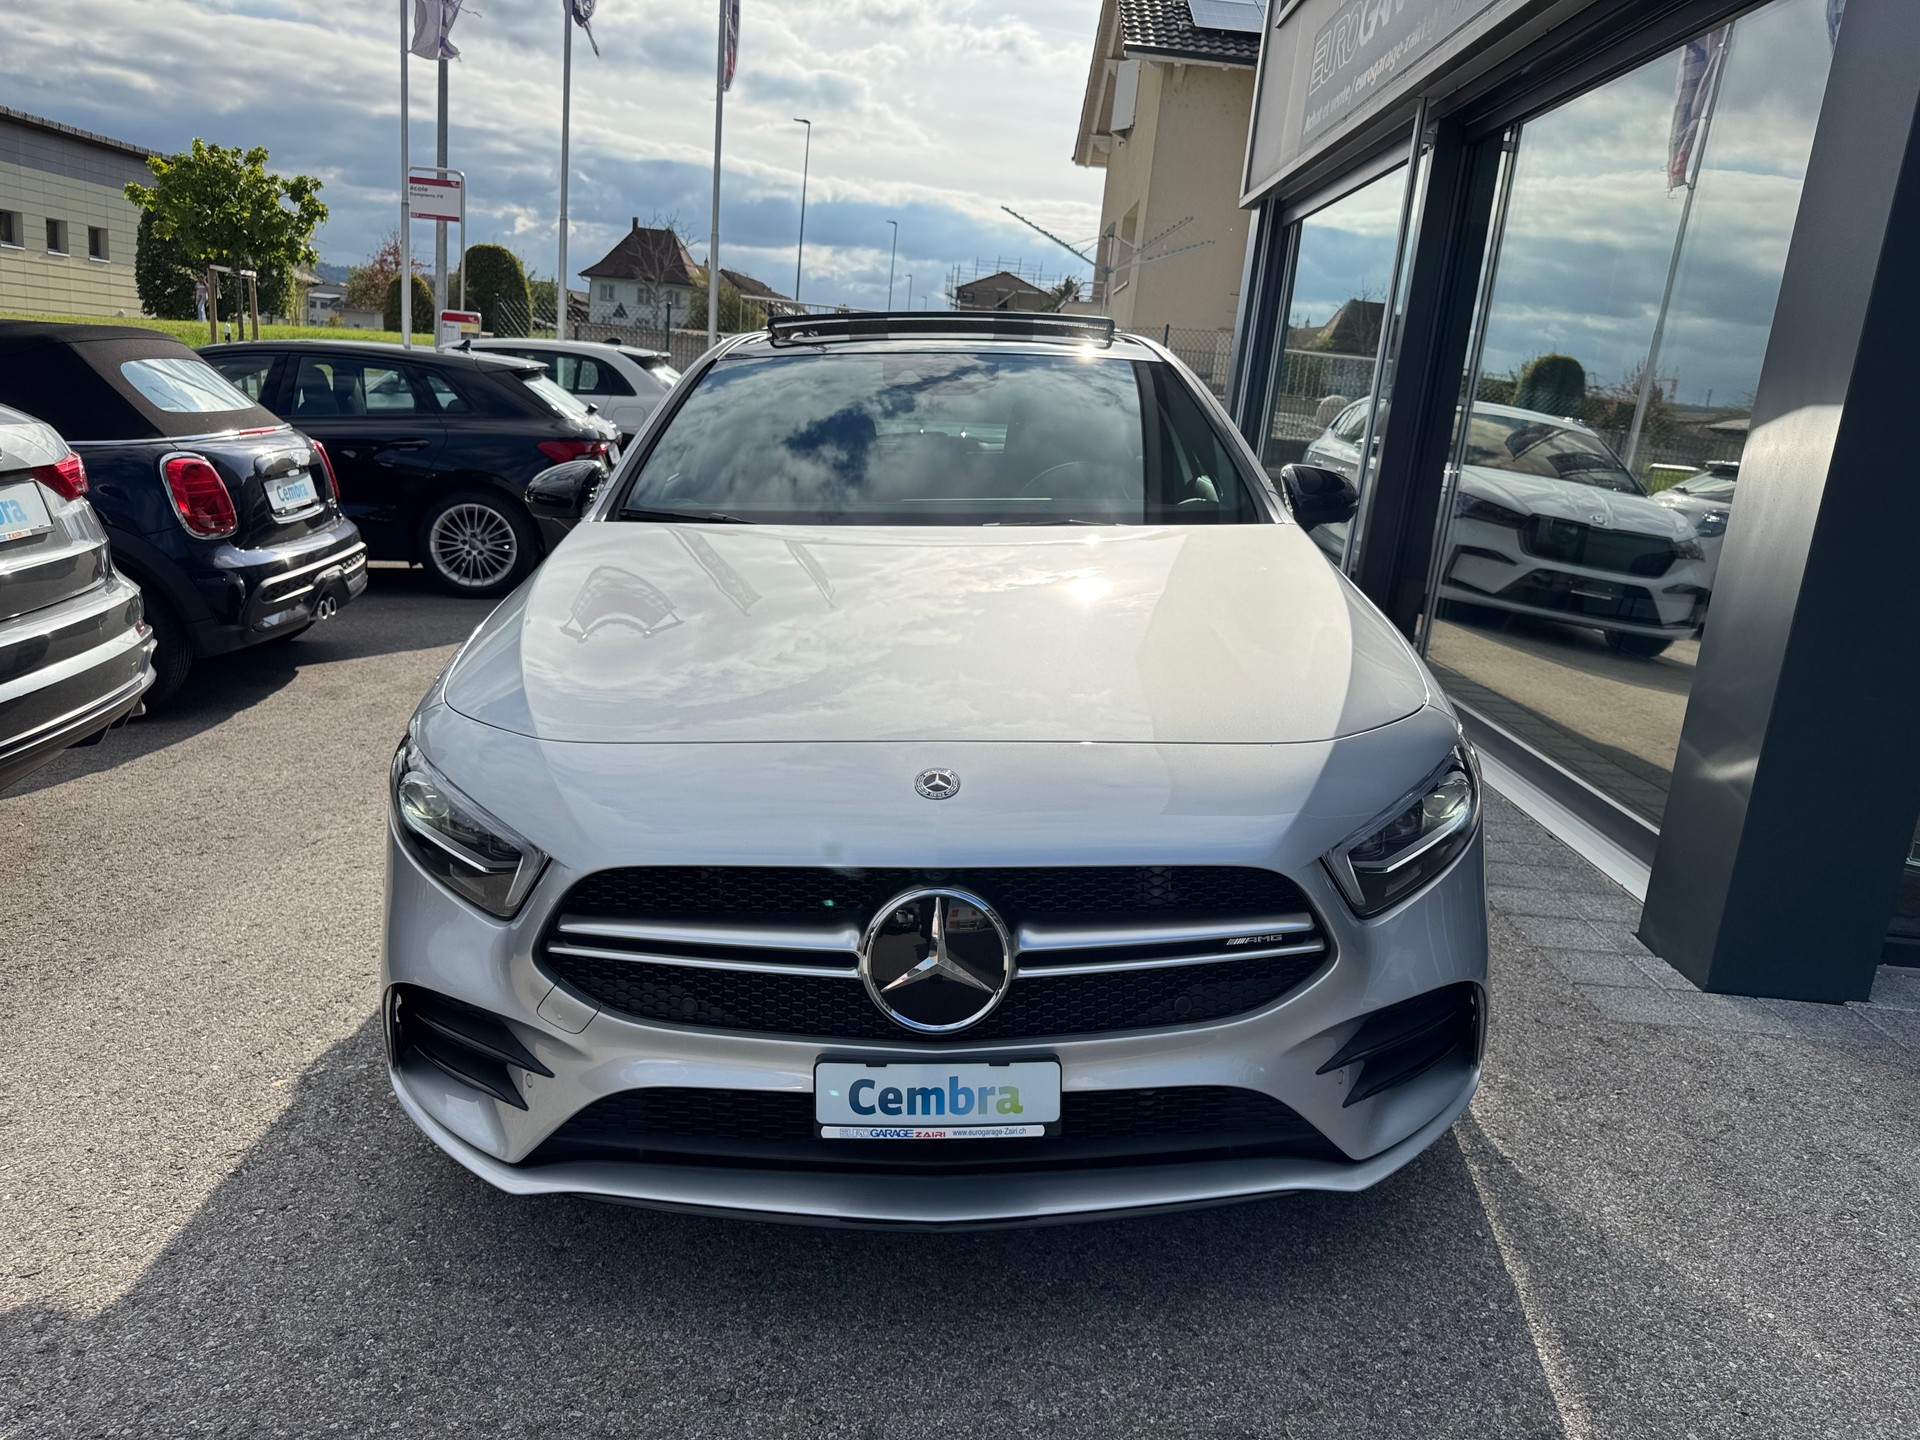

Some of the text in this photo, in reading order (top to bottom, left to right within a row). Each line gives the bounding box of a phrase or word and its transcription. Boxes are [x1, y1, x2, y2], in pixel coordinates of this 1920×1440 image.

[276, 483, 309, 502] Cembra
[848, 1076, 1024, 1116] Cembra
[839, 1128, 914, 1138] EUROGARAGE
